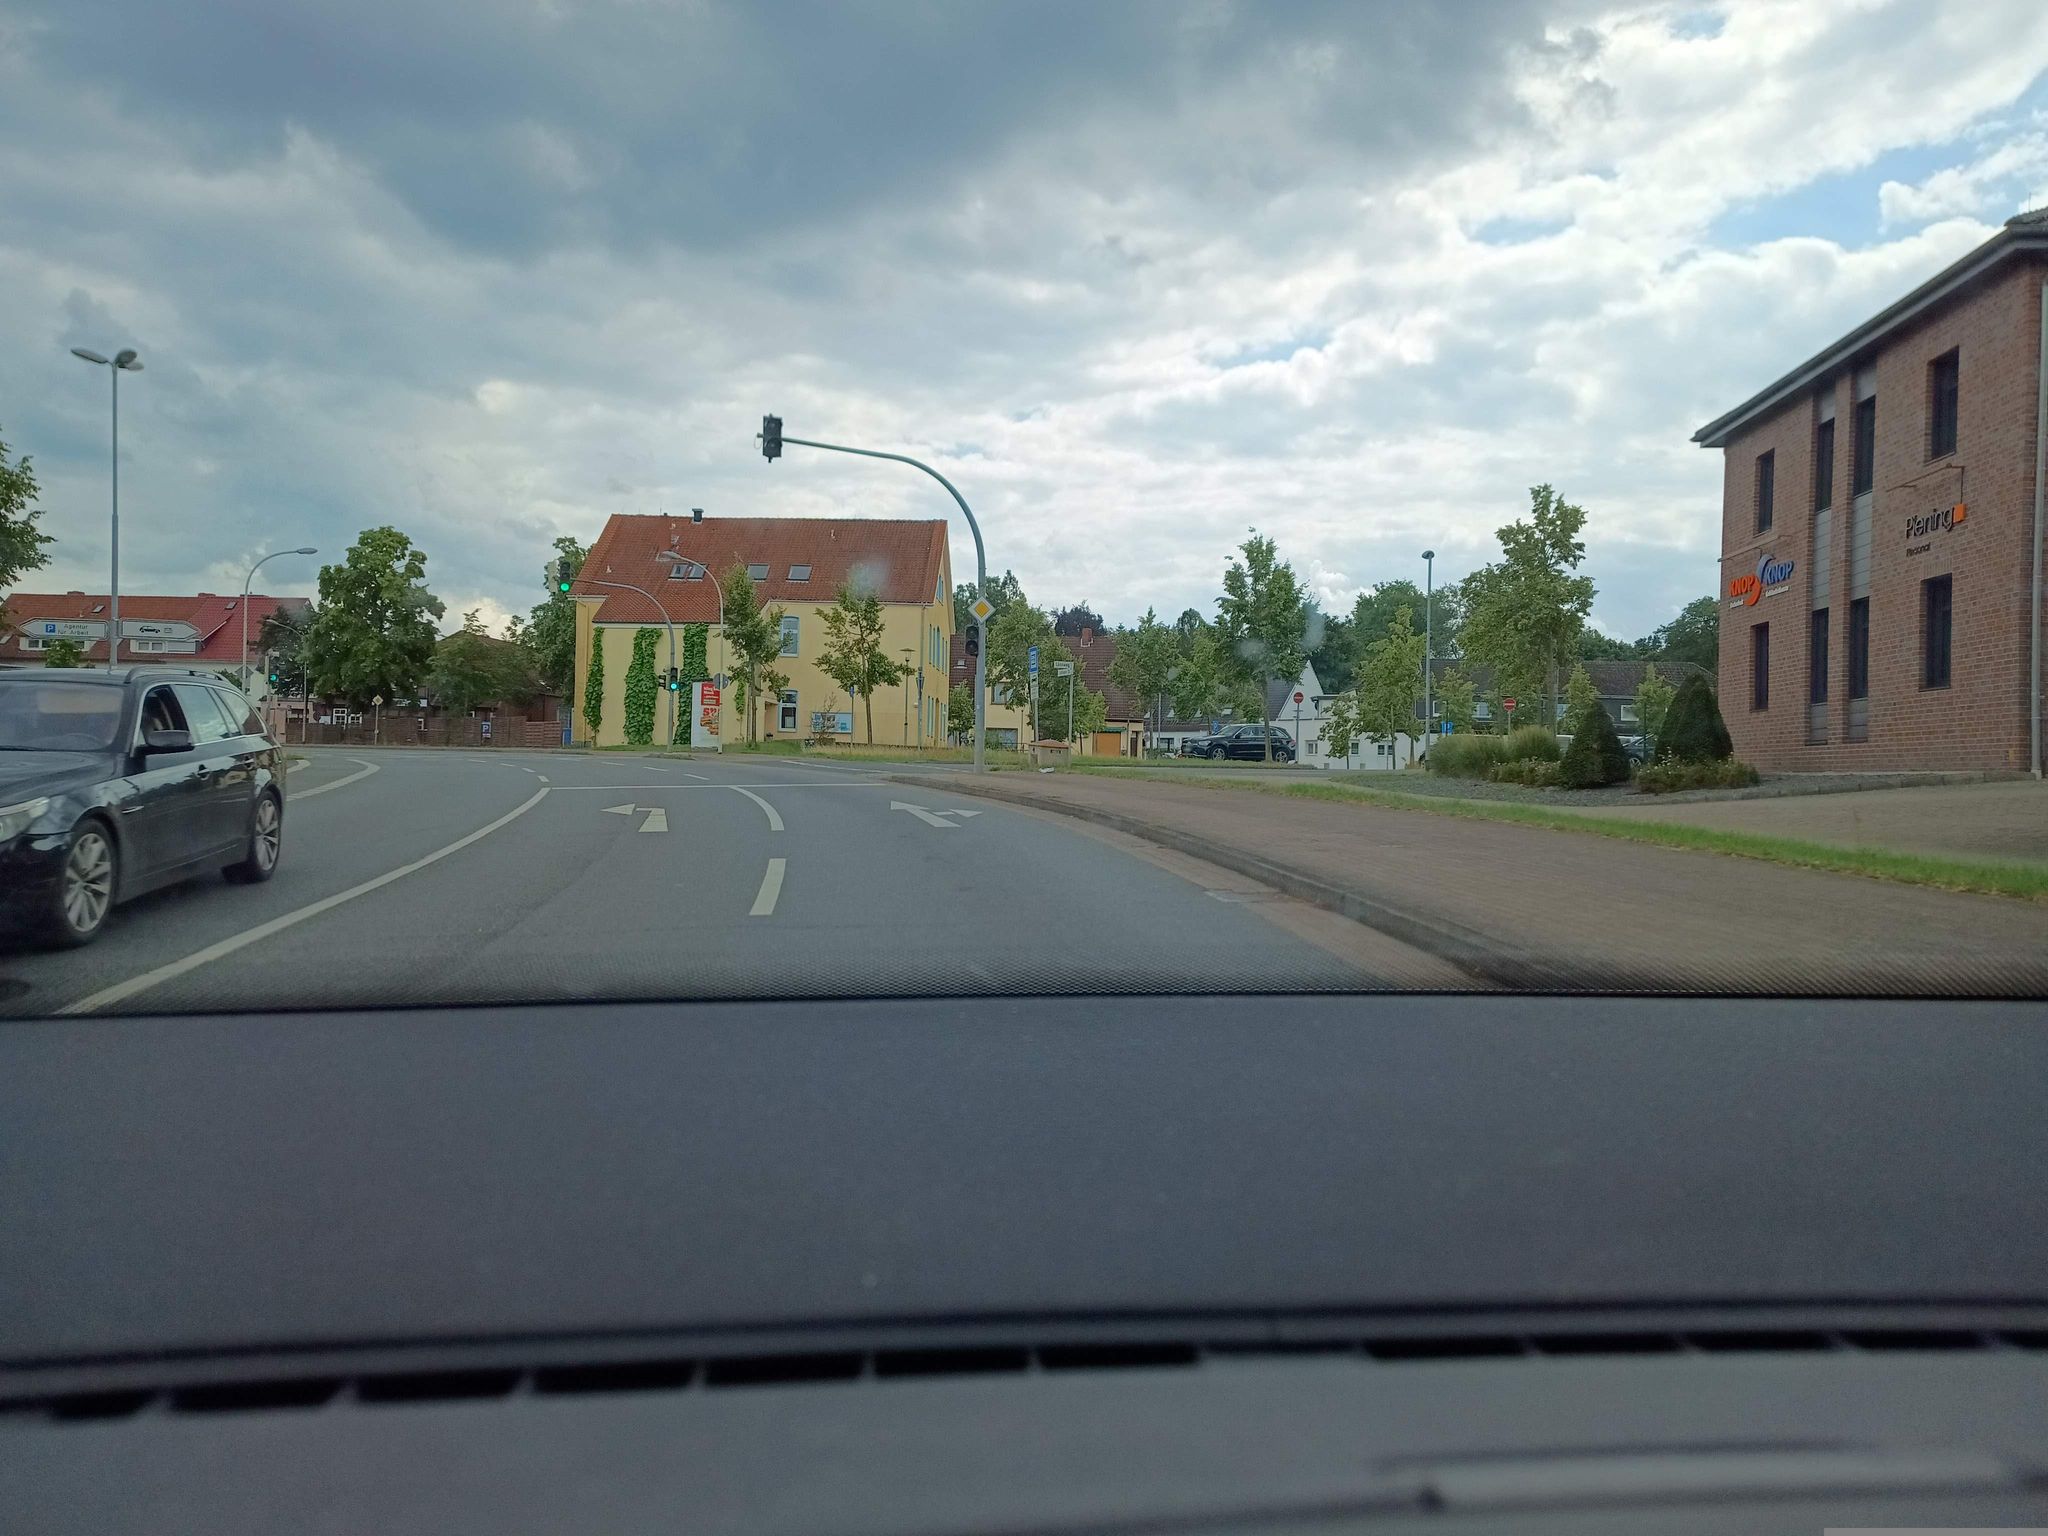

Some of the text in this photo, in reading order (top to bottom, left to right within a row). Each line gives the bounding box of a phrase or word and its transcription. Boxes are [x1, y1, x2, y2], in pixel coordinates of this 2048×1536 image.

[1905, 508, 1954, 538] Piening
[1765, 561, 1794, 585] KNOP
[1728, 575, 1756, 597] KNOP
